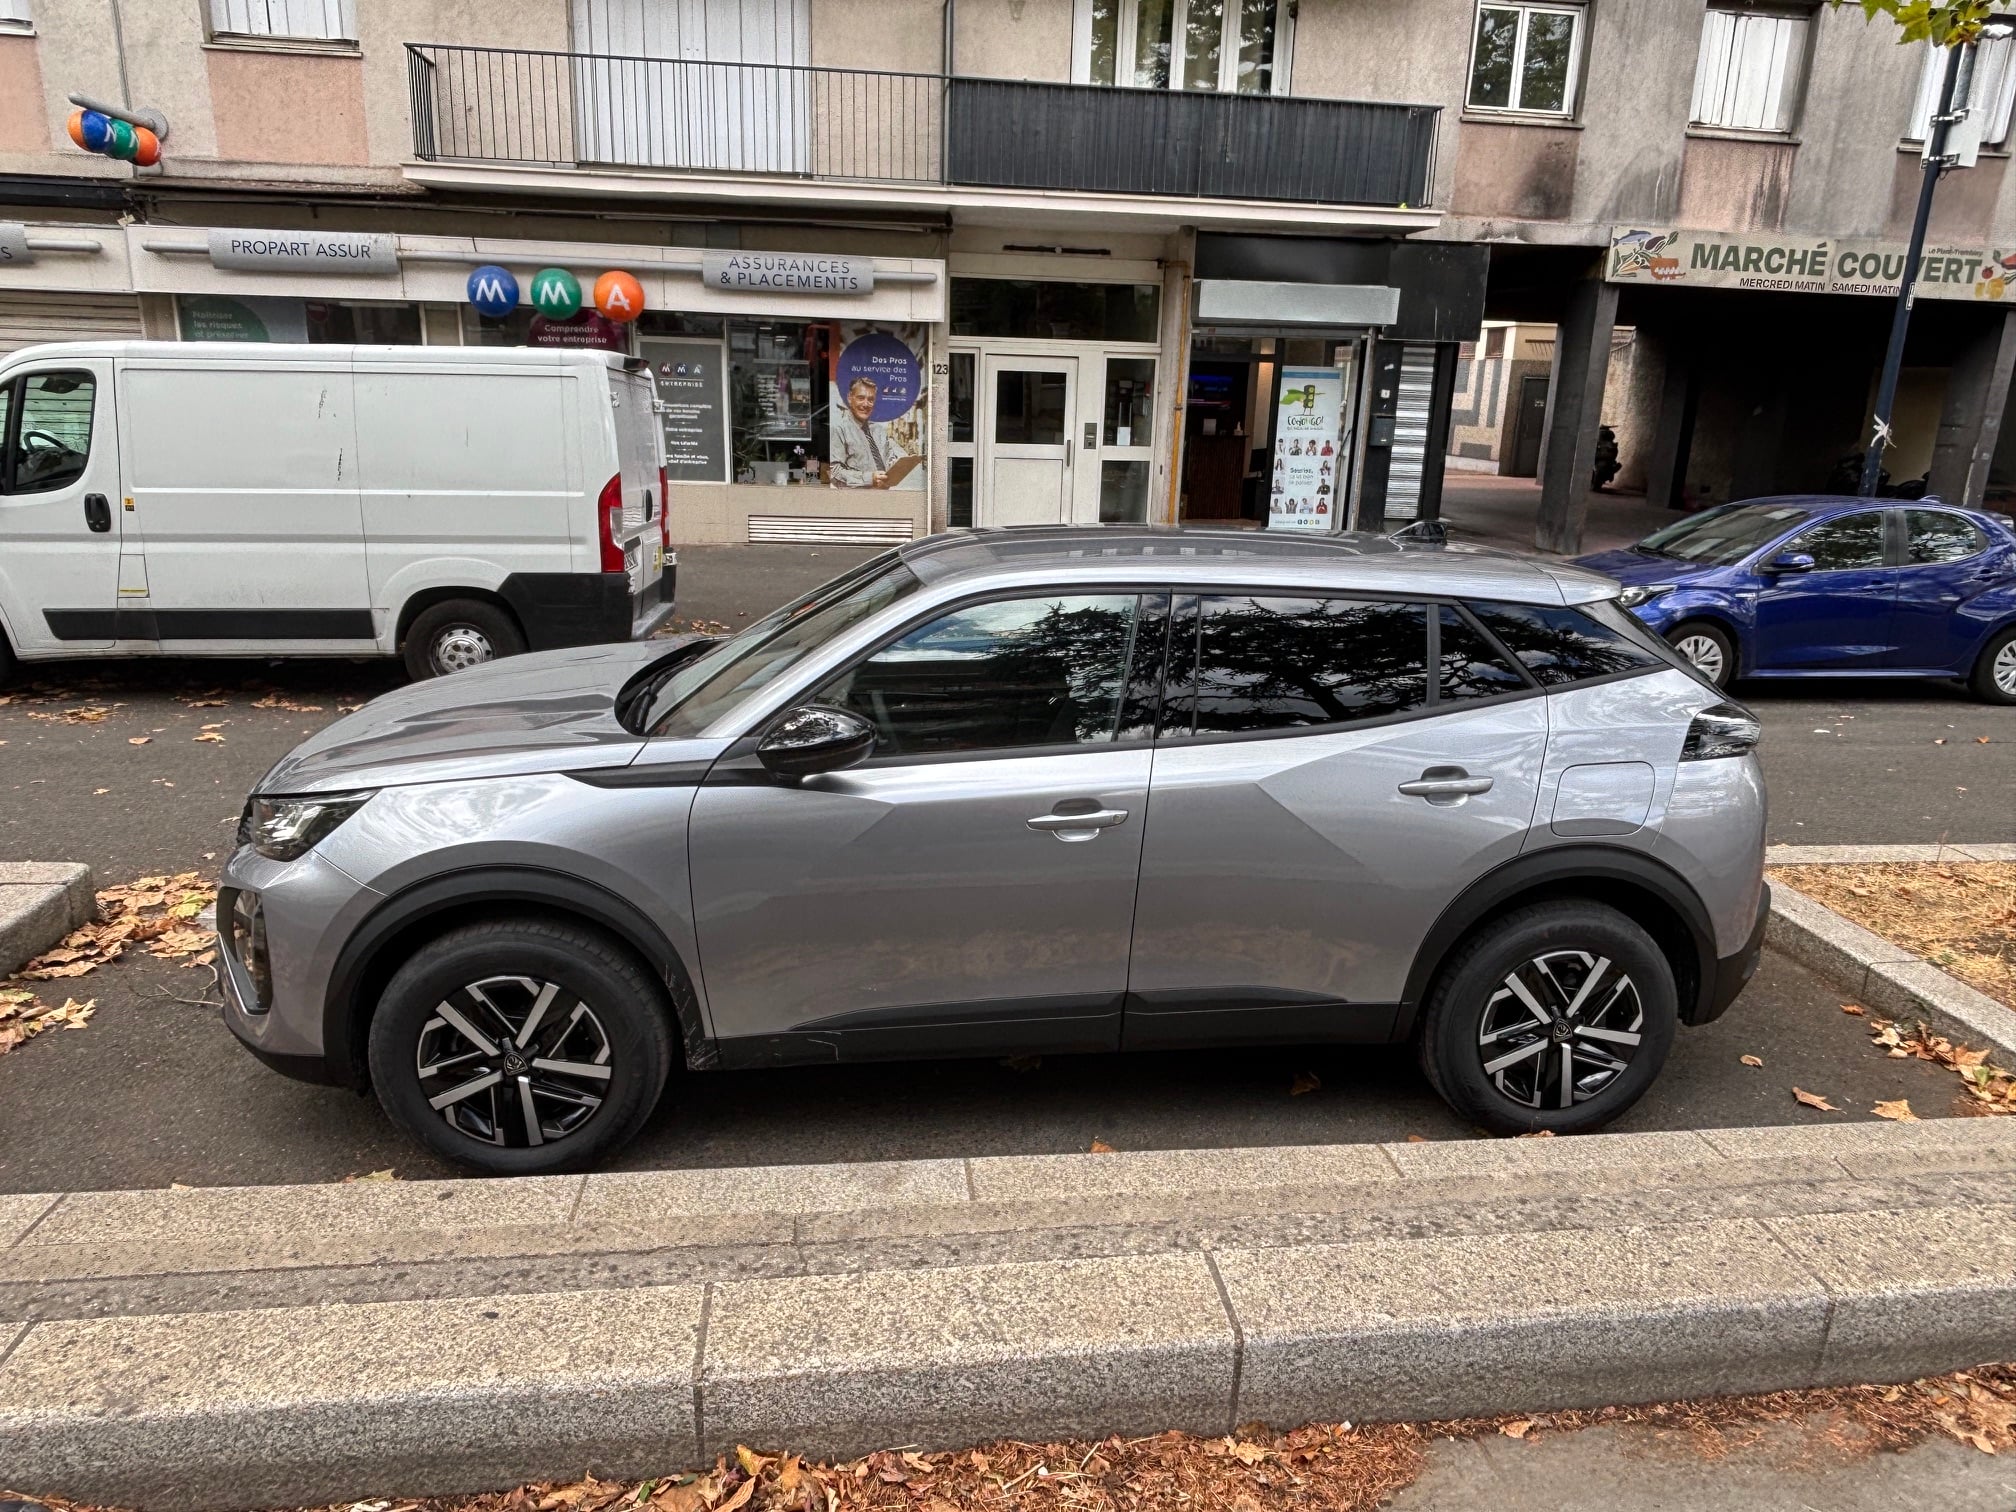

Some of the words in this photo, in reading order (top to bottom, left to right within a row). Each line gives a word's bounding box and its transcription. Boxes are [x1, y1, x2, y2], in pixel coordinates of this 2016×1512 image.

[231, 239, 310, 257] PROPART
[315, 243, 371, 259] ASSUR
[1690, 241, 1828, 277] MARCHÉ
[728, 256, 851, 274] ASSURANCES
[720, 271, 731, 284] &
[737, 272, 858, 290] PLACEMENTS
[1739, 277, 1793, 290] MERCREDI
[1794, 281, 1826, 291] MATIN
[1831, 282, 1871, 293] SAMEDI
[544, 324, 600, 335] Comprendre
[537, 335, 560, 343] votre
[562, 336, 608, 346] entreprise
[872, 356, 887, 364] Des
[889, 356, 907, 365] Pros
[863, 365, 891, 373] service
[892, 365, 907, 374] des
[932, 364, 949, 375] 123
[889, 375, 907, 383] Pros
